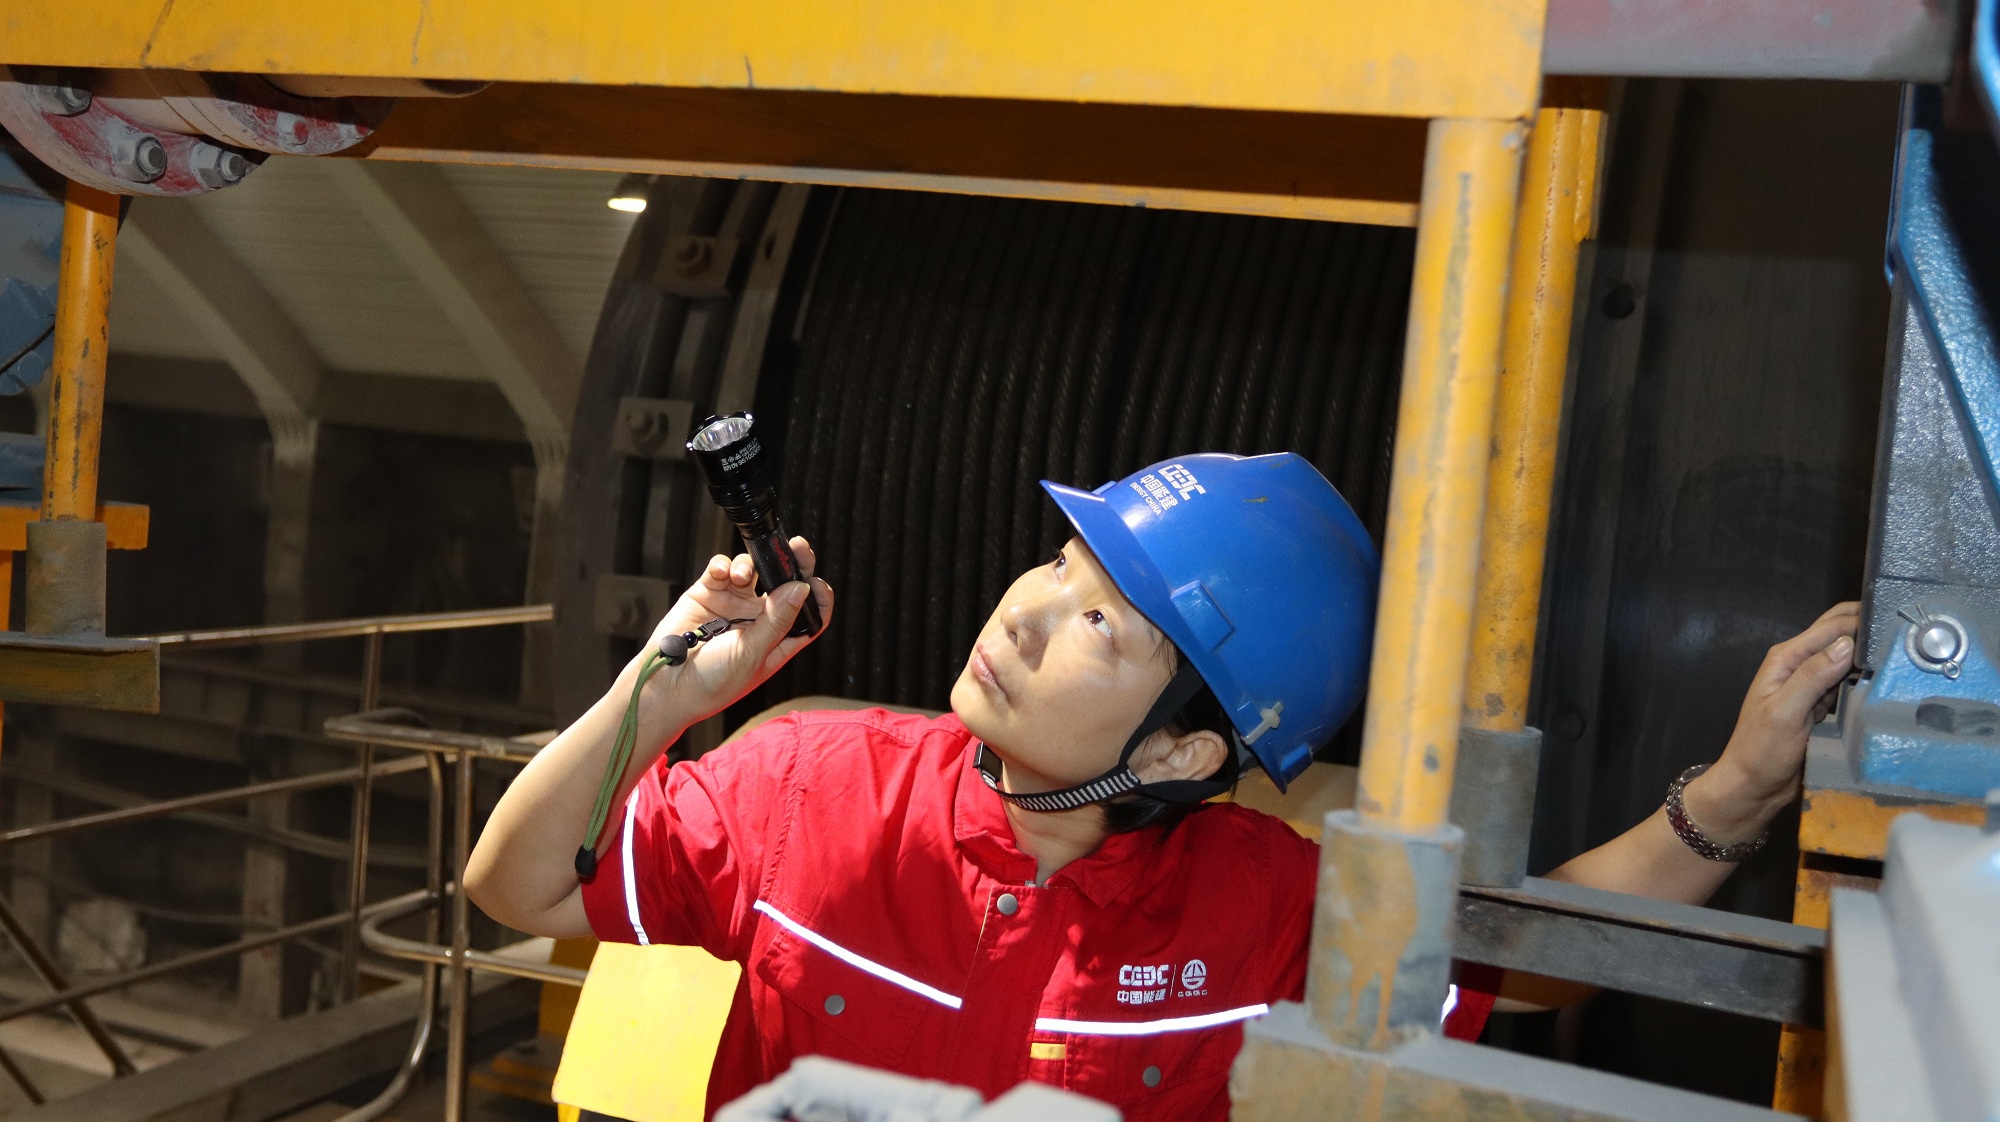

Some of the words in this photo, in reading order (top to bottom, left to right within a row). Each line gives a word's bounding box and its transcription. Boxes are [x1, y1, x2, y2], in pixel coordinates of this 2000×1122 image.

[1129, 481, 1149, 498] ENERGY
[1145, 496, 1162, 516] CHINA
[1139, 473, 1179, 511] 中国能建
[1117, 989, 1166, 1004] 中国能建
